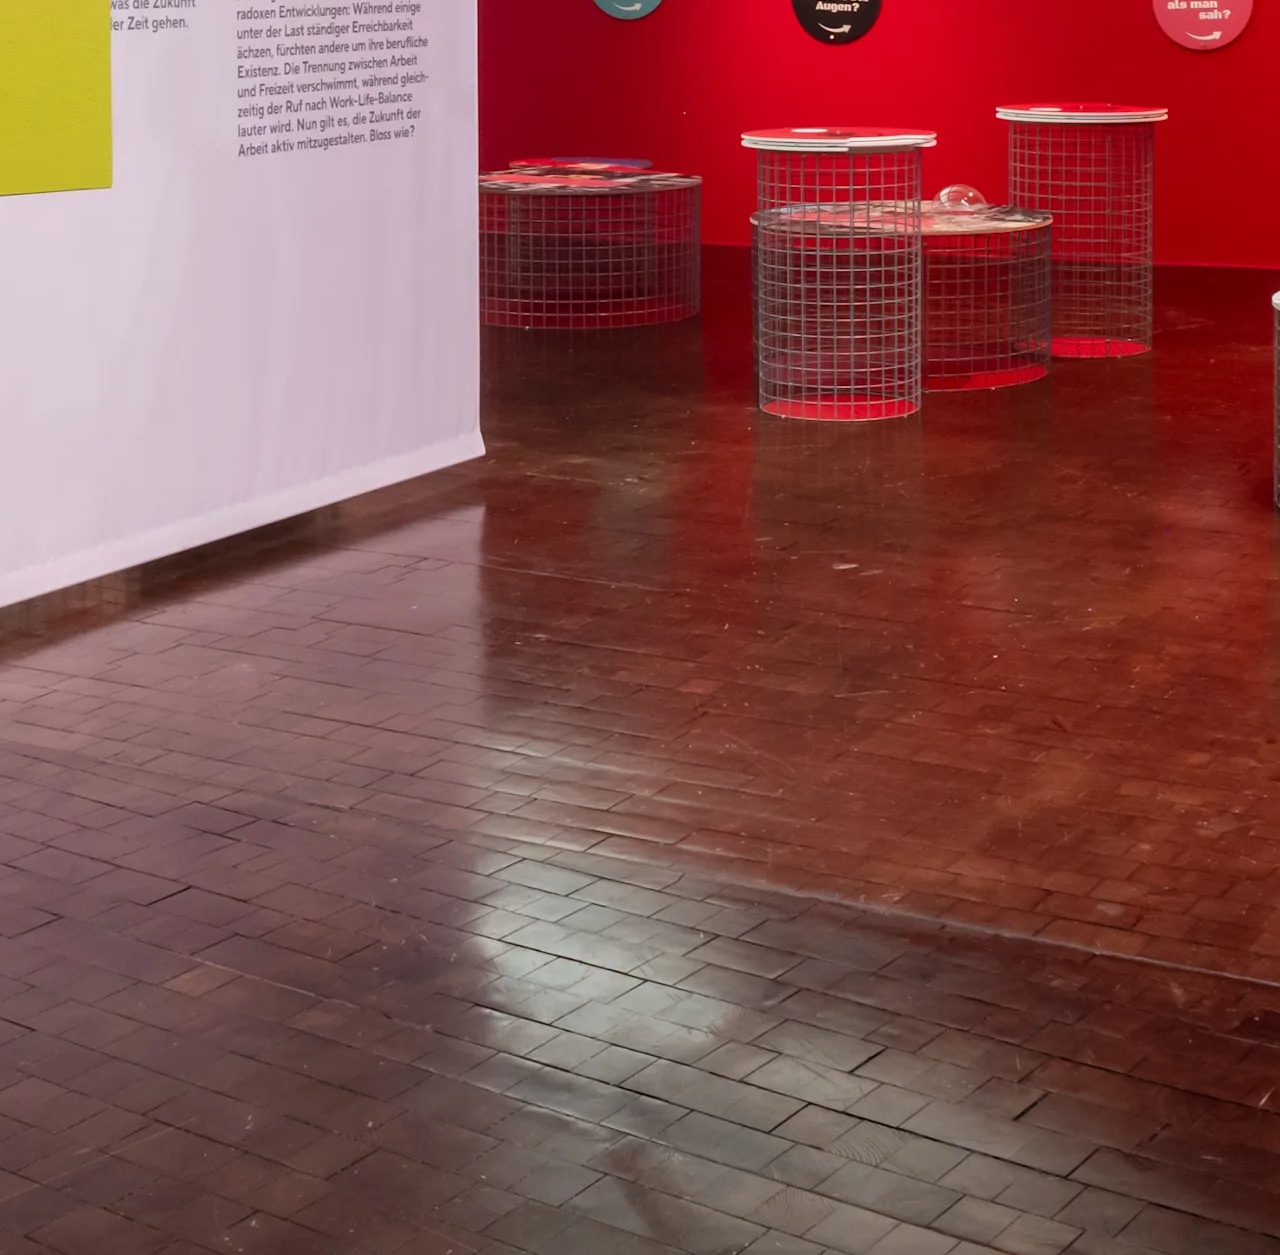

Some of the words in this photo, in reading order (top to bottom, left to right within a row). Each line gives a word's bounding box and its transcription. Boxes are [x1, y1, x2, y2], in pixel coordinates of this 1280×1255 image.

[816, 1, 860, 13] Augen?
[1167, 0, 1187, 9] als
[1190, 0, 1218, 8] man
[1199, 10, 1231, 19] sah?
